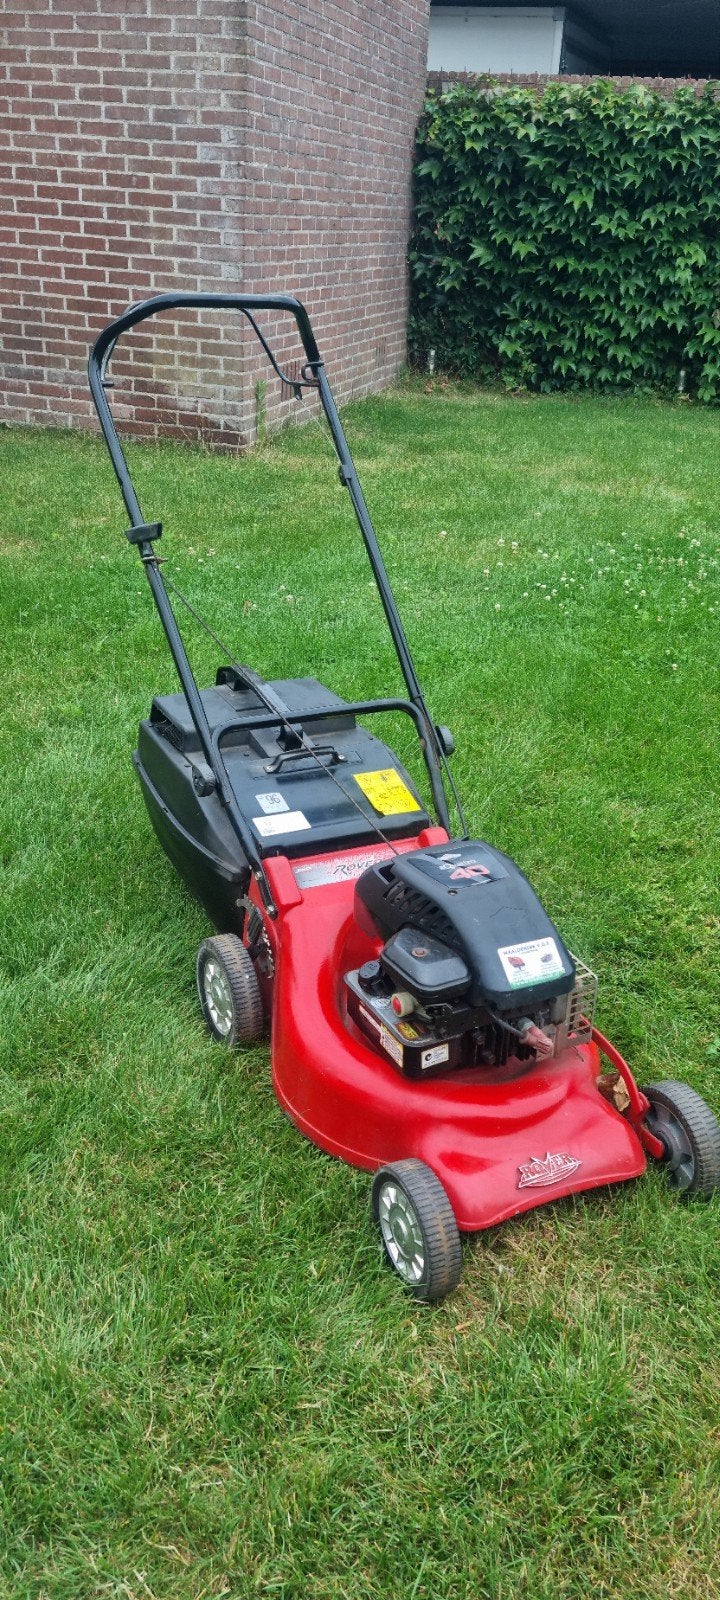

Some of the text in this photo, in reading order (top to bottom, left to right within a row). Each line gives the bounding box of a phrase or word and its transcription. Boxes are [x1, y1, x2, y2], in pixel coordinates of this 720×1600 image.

[265, 793, 281, 805] 96
[449, 864, 491, 880] 40
[518, 1152, 581, 1183] ROVER
